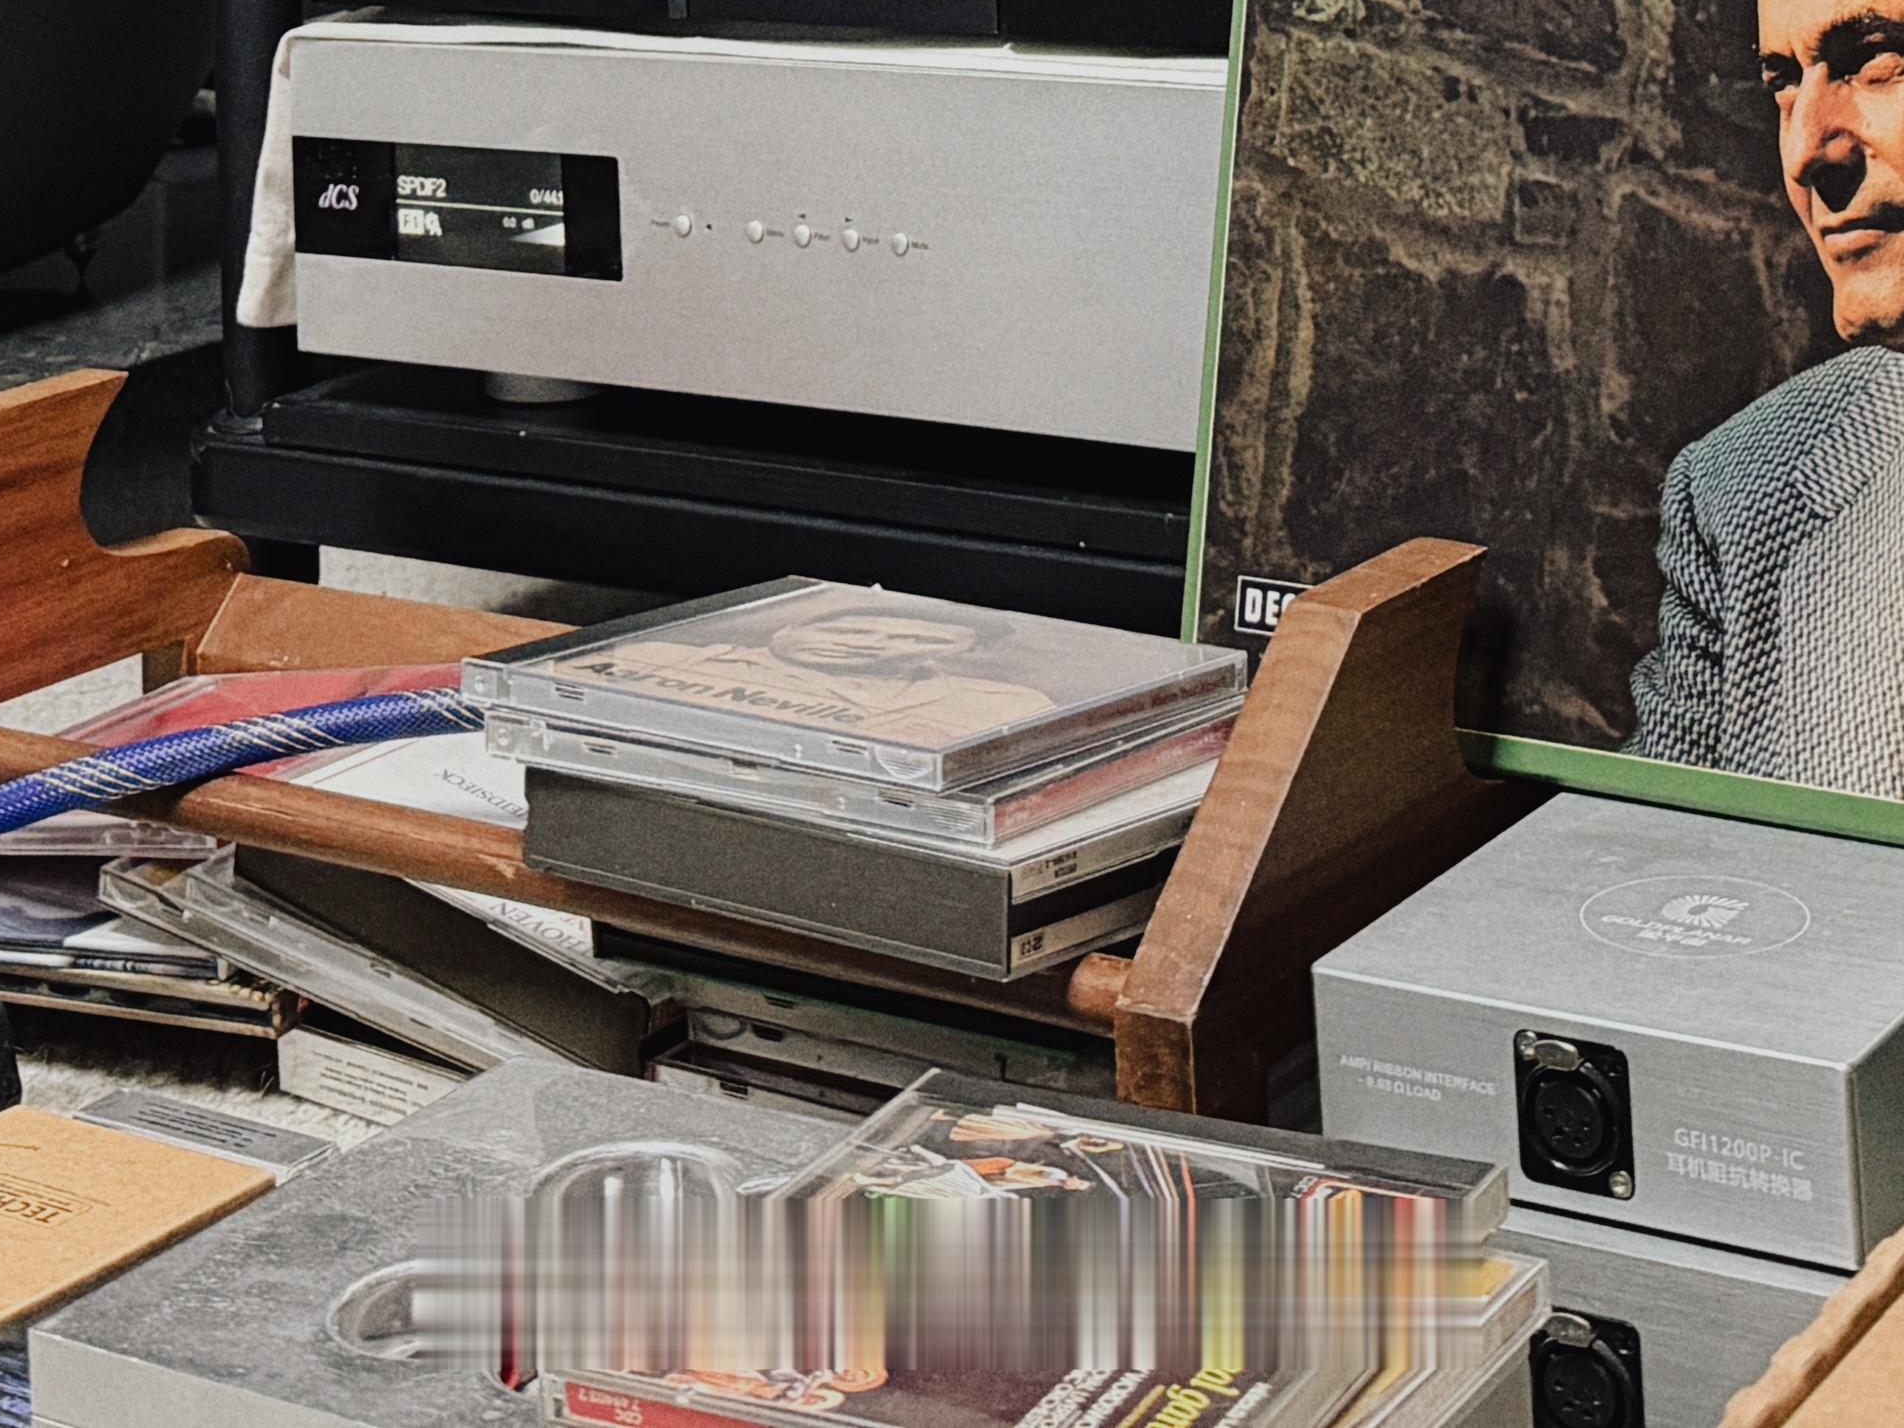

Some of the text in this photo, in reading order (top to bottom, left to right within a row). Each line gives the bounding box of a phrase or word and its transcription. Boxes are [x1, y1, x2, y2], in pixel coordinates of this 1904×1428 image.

[317, 183, 360, 212] dCS
[572, 661, 865, 725] Aaron Neville
[1600, 913, 1753, 945] GOLDPLANAR
[1406, 1083, 1442, 1102] LOAD
[1423, 1070, 1496, 1096] INTERFACE
